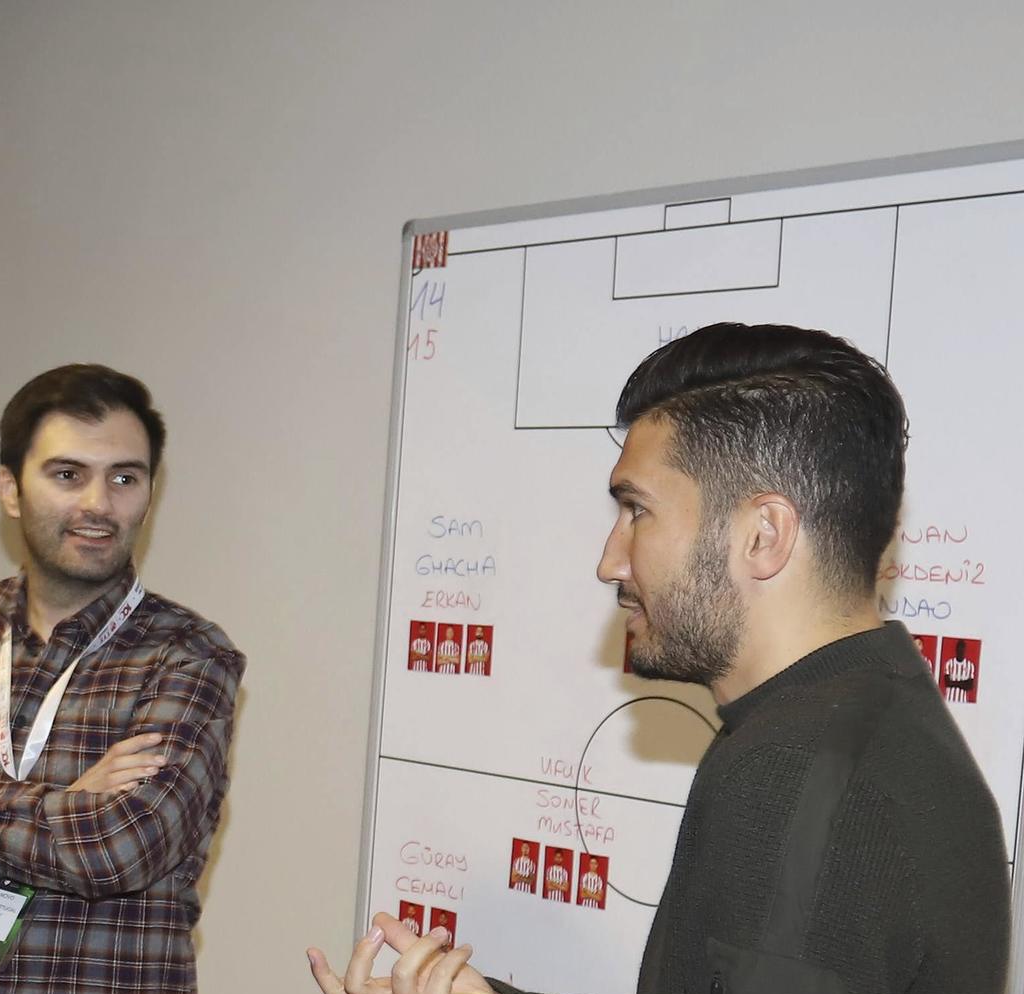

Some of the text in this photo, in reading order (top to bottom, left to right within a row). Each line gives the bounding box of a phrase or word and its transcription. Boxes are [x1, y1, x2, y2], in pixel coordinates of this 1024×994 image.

[410, 281, 446, 320] 14
[407, 329, 439, 360] 15
[428, 516, 483, 538] SAM
[901, 525, 968, 544] NAN
[416, 554, 496, 576] GHACHA
[421, 590, 481, 611] ERKAN
[536, 788, 602, 819] SONER
[537, 815, 616, 844] MUSTAFA
